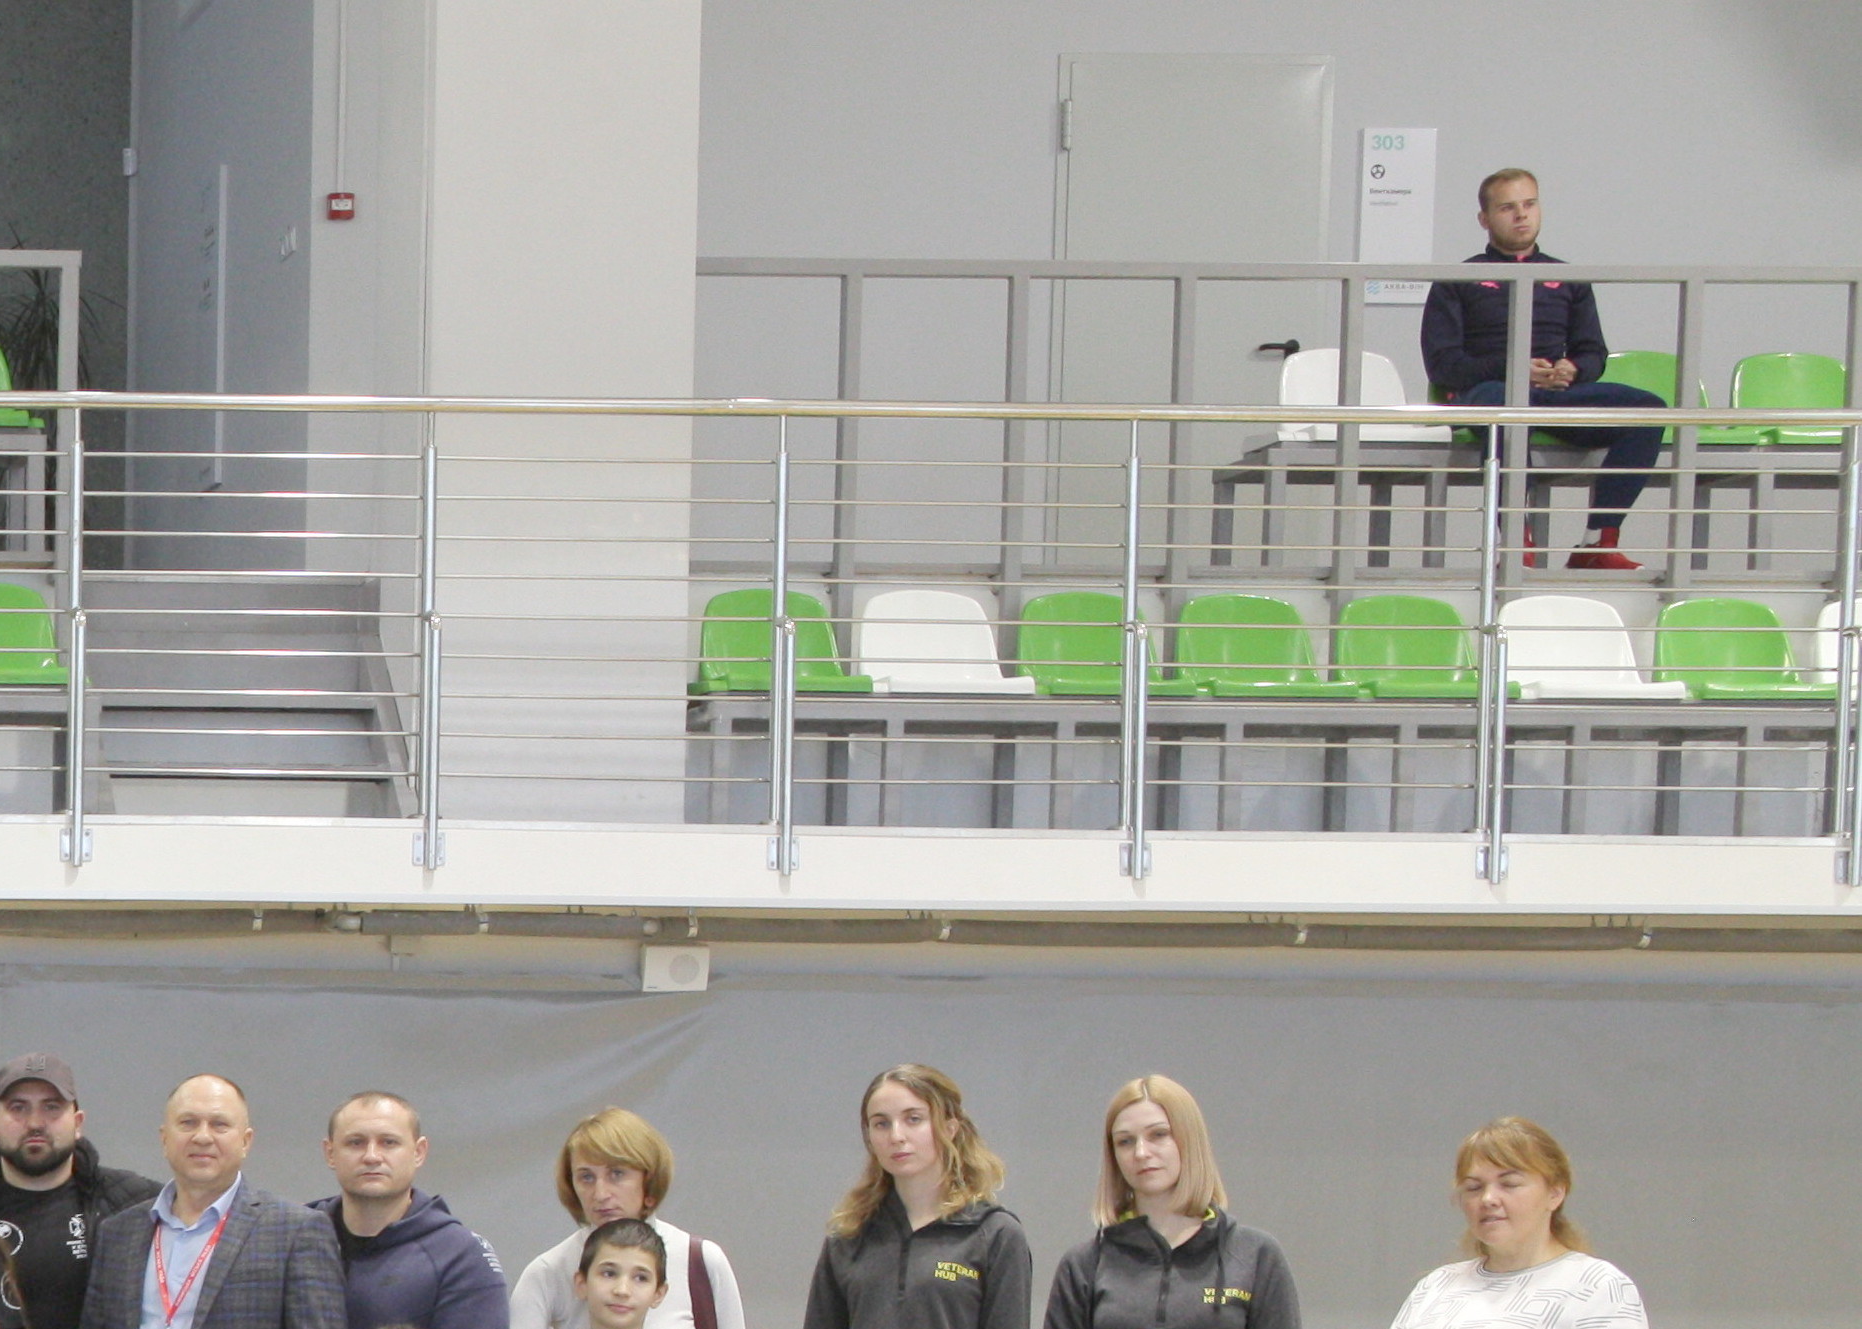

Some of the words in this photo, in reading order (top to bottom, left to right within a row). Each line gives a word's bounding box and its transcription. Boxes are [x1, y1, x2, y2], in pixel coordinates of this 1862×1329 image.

[1371, 134, 1405, 151] 303
[934, 1269, 957, 1282] HUB
[937, 1261, 979, 1280] VETERAN
